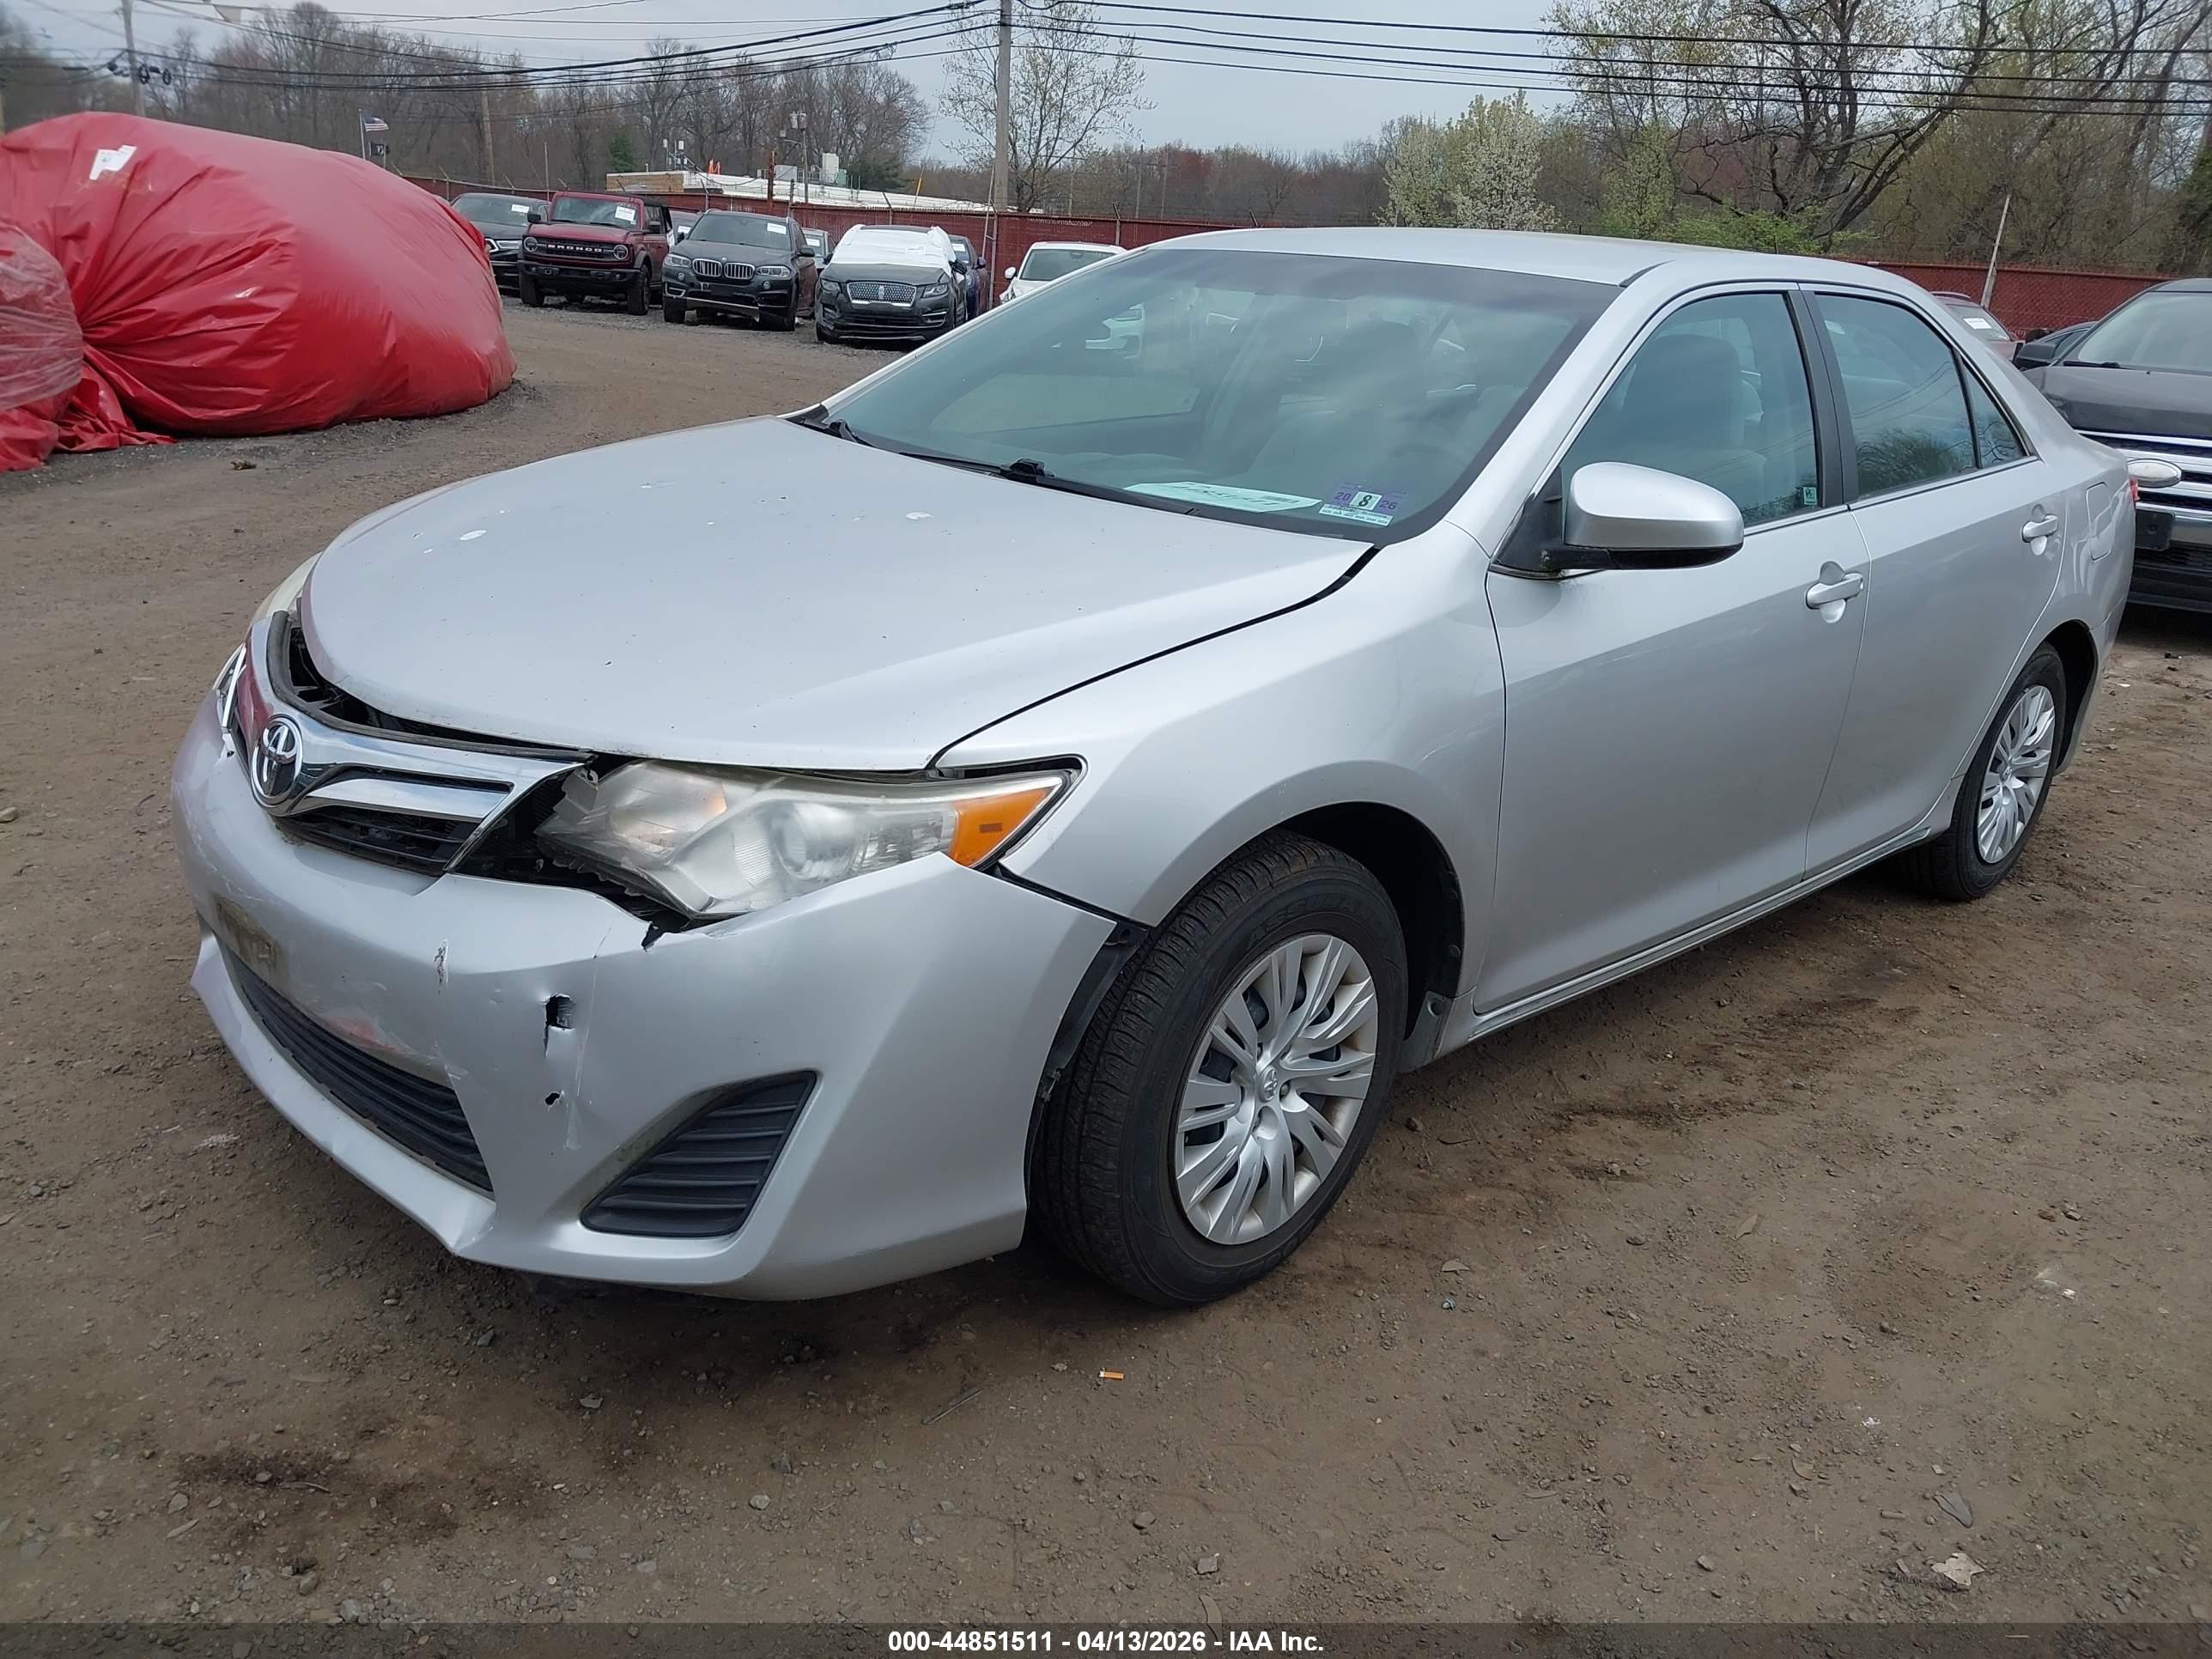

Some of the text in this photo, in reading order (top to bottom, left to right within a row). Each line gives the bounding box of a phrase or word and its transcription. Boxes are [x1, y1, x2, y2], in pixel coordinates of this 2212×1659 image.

[547, 244, 603, 252] BRONCO
[1334, 491, 1398, 510] 20 8 26
